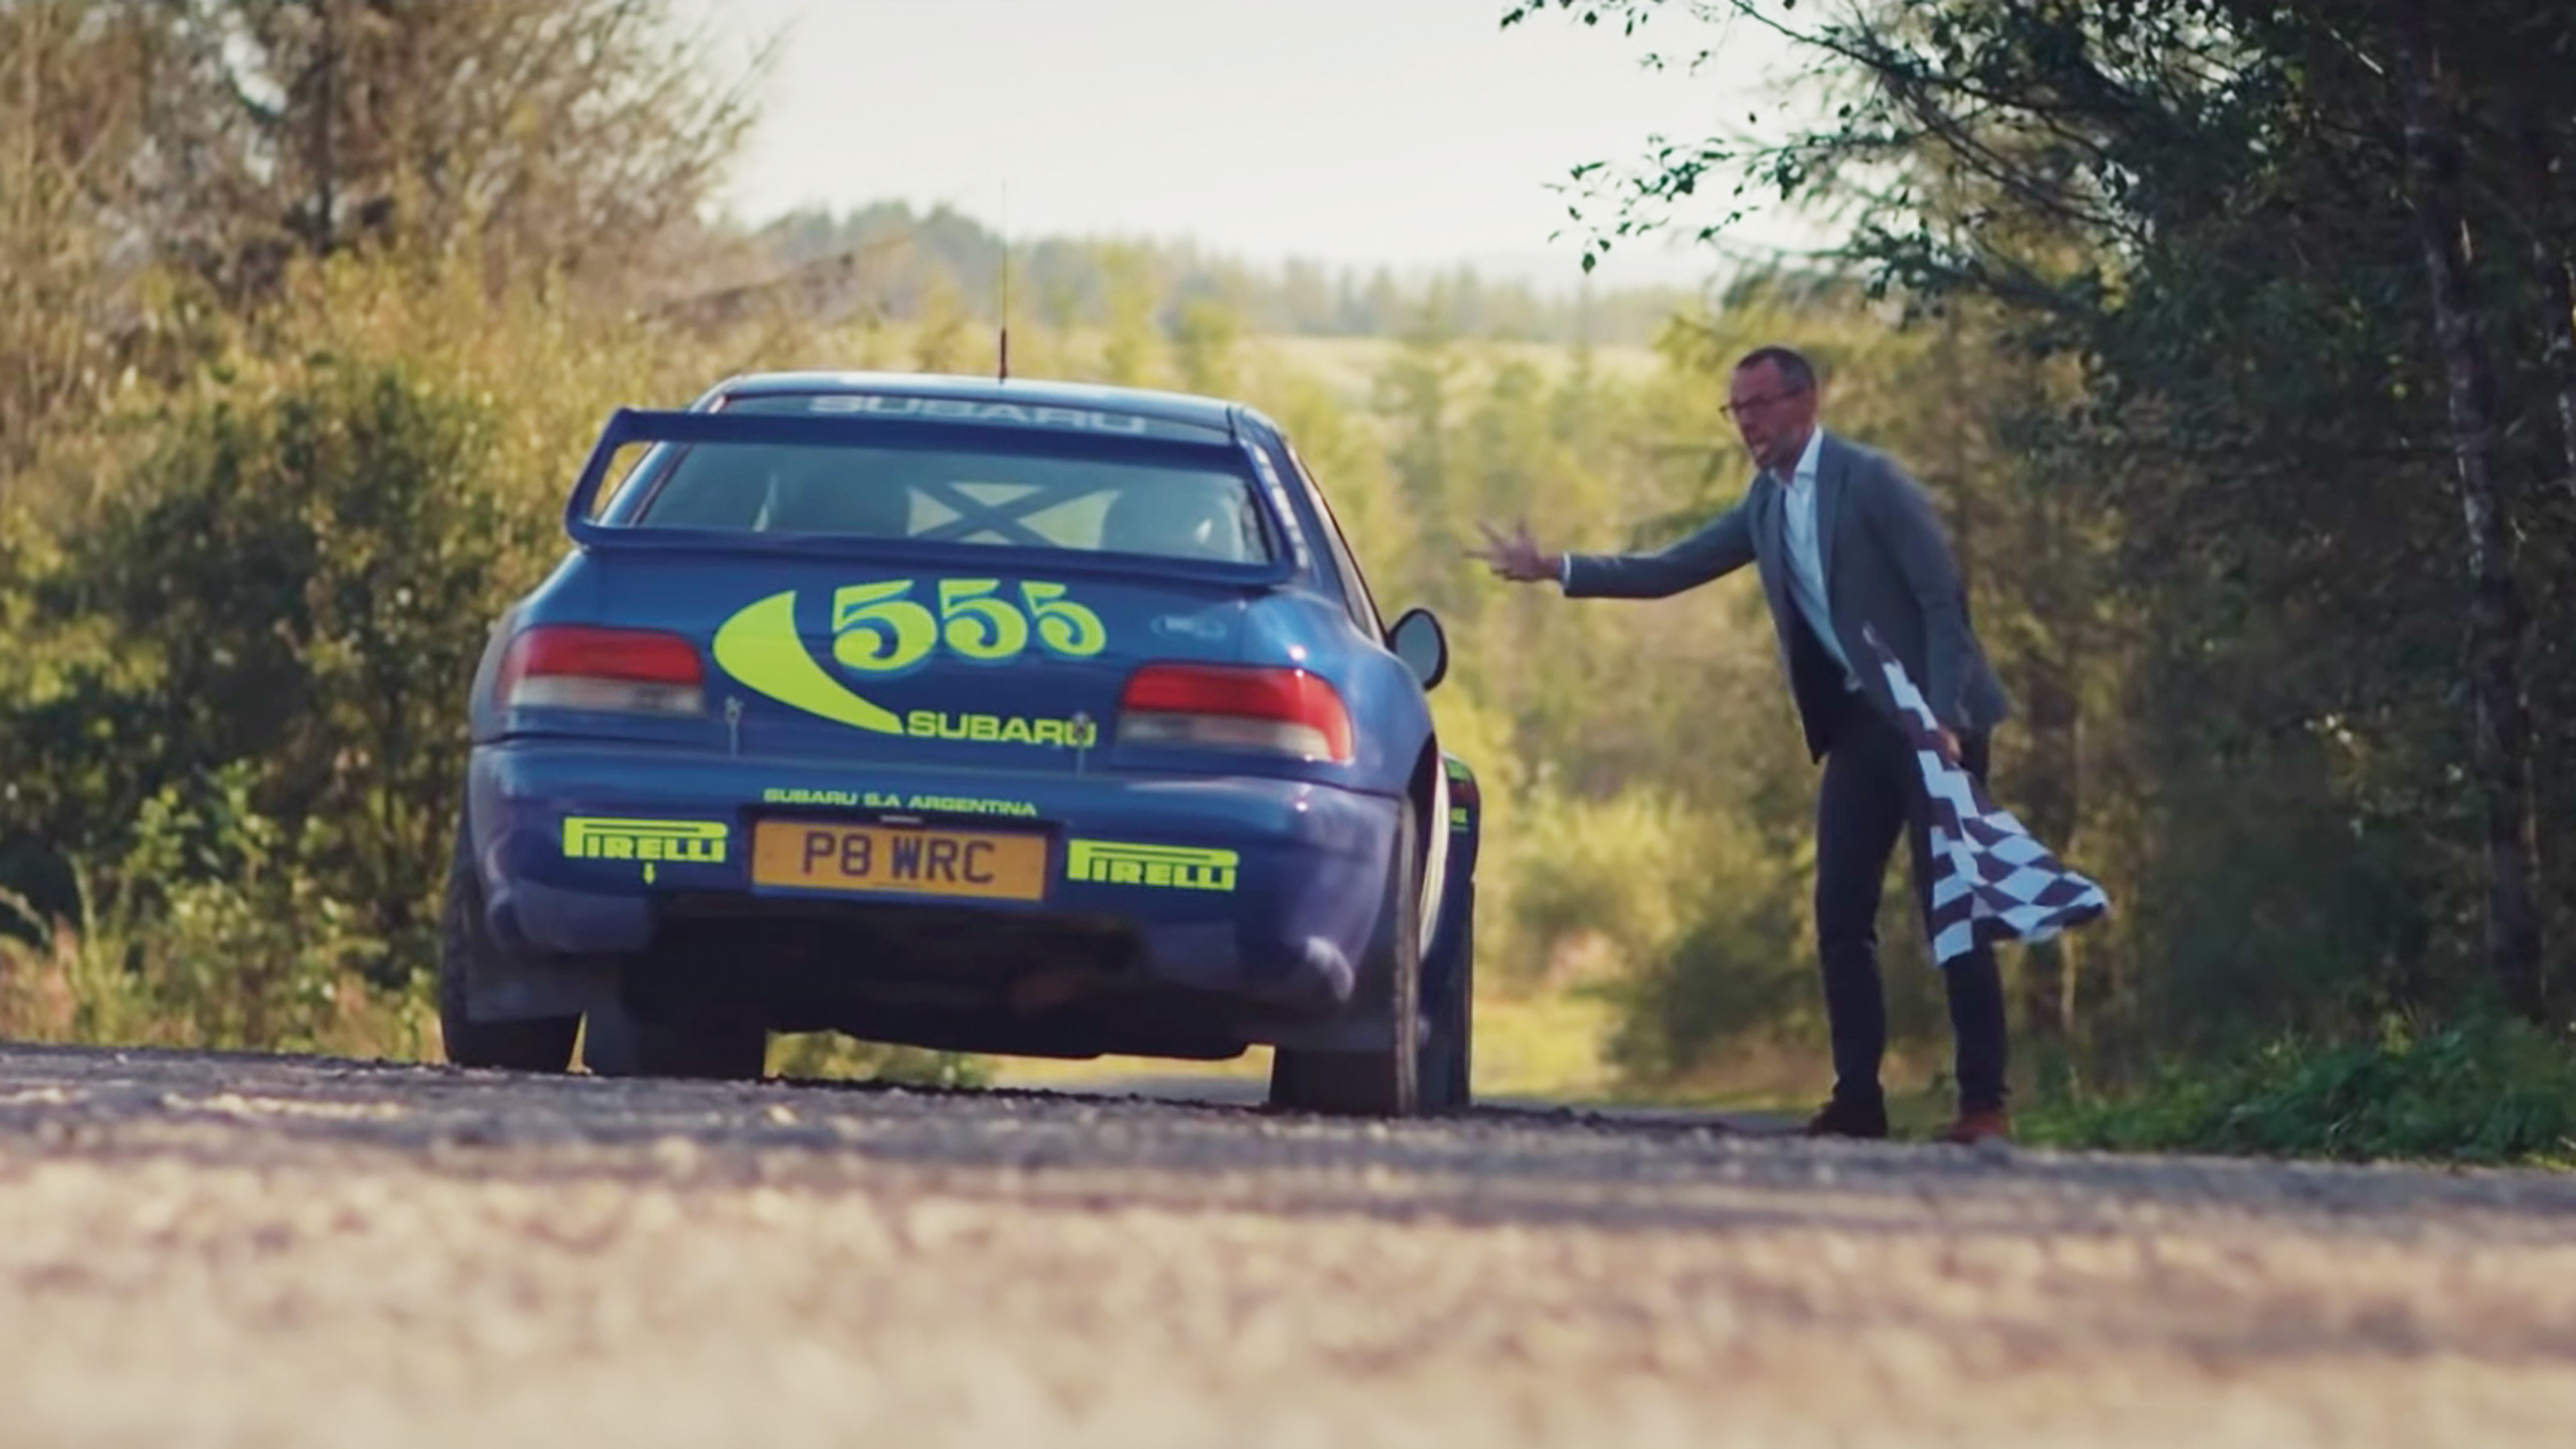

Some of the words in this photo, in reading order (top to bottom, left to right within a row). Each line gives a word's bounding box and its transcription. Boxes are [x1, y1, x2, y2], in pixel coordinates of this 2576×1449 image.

[809, 394, 1146, 435] SUBARU
[832, 578, 1107, 671] 555
[907, 710, 1097, 748] SUBARU
[764, 787, 858, 805] SUBARU
[909, 795, 1038, 817] ARGENTINA
[564, 816, 729, 863] PIRELLI
[803, 830, 873, 877] P8
[891, 835, 996, 883] WRC
[1067, 838, 1239, 892] PIRELLI
